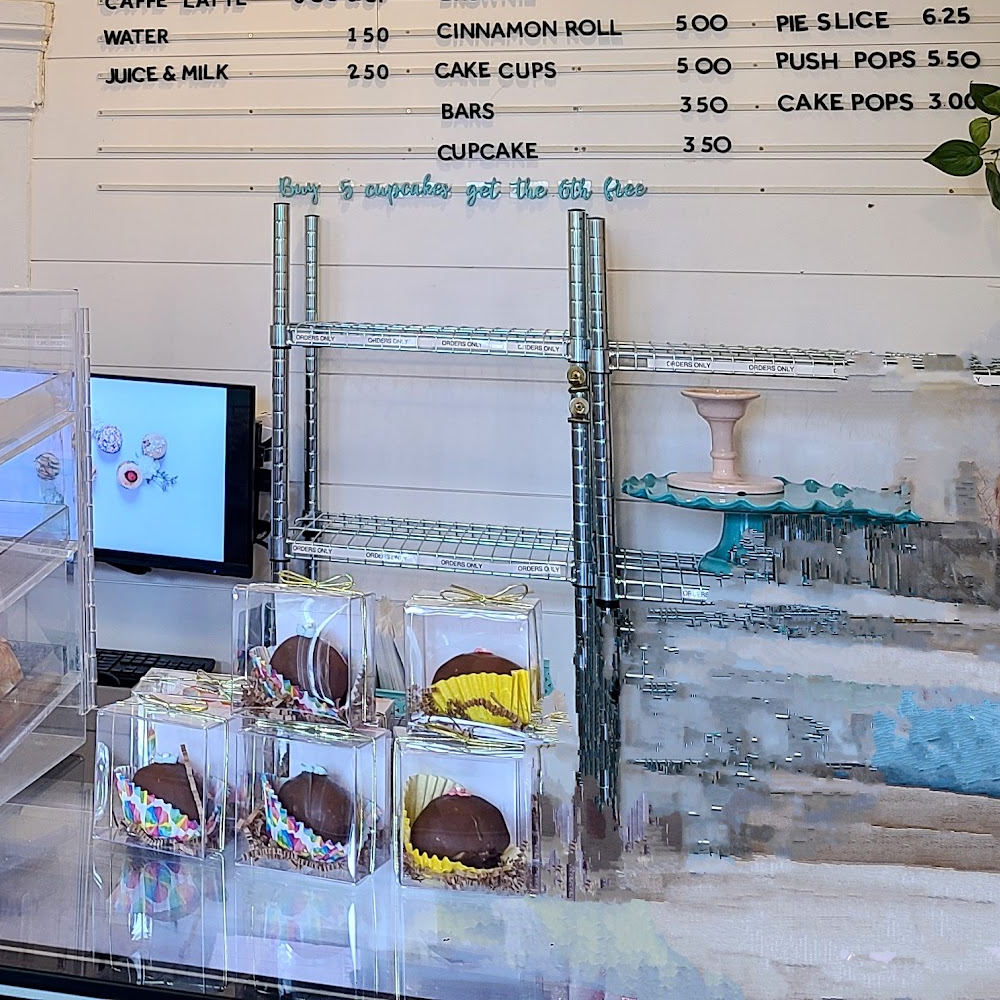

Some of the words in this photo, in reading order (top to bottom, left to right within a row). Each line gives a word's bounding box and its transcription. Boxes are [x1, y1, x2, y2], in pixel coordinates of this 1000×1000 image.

[437, 21, 557, 38] CINNAMON
[566, 20, 622, 36] ROLL
[777, 15, 808, 31] PIE
[818, 12, 889, 30] SLICE
[104, 29, 168, 45] WATER
[776, 53, 837, 70] PUSH
[855, 51, 915, 69] POPS
[106, 67, 158, 84] JUICE
[163, 66, 175, 81] &
[182, 65, 228, 80] MILK
[435, 62, 490, 78] CAKE
[499, 62, 556, 78] CUPS
[442, 103, 494, 119] BARS
[778, 94, 843, 111] CAKE
[852, 94, 913, 111] POPS
[438, 143, 538, 160] CUPCAKE
[279, 176, 320, 205] Buy
[340, 179, 353, 200] 5
[365, 173, 452, 206] cupcakes
[466, 177, 502, 206] get
[510, 177, 549, 199] the
[558, 177, 593, 200] 6th
[603, 176, 648, 201] free
[293, 545, 316, 553] ORDERS
[441, 559, 466, 567] ORDERS
[467, 561, 482, 569] ONLY
